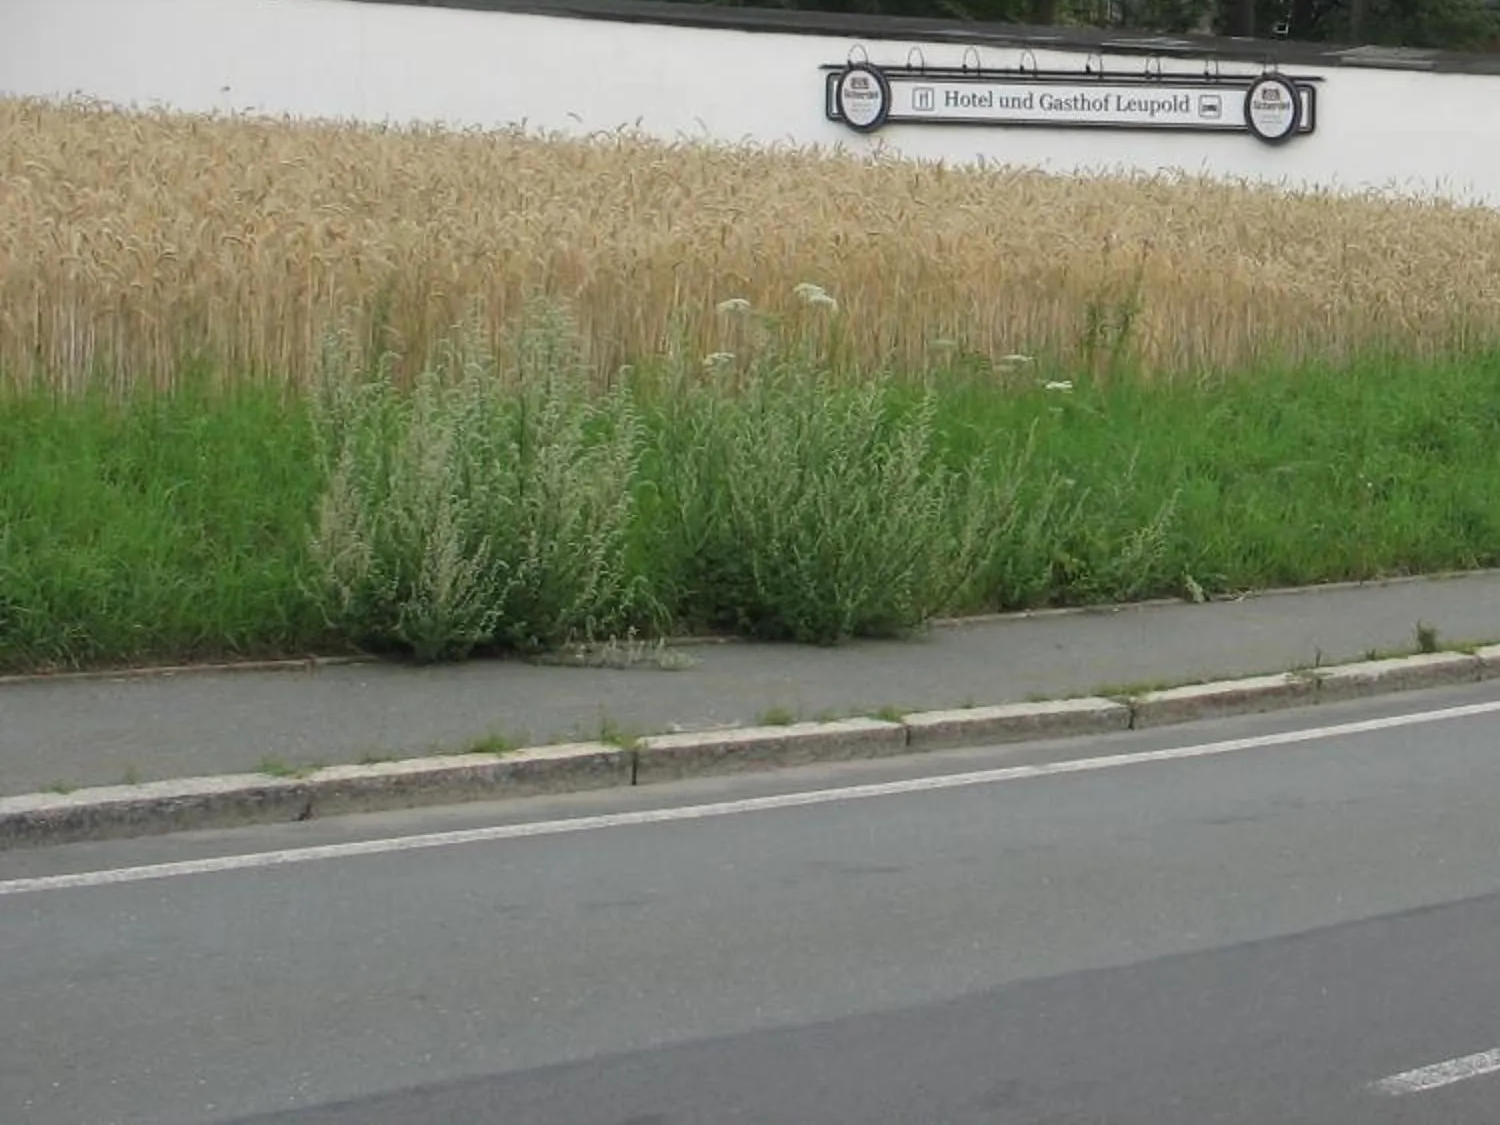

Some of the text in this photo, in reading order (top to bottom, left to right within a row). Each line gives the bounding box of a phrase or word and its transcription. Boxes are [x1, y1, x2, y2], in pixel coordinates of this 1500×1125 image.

[944, 90, 1190, 117] Hotel und Gasthof Leupold
